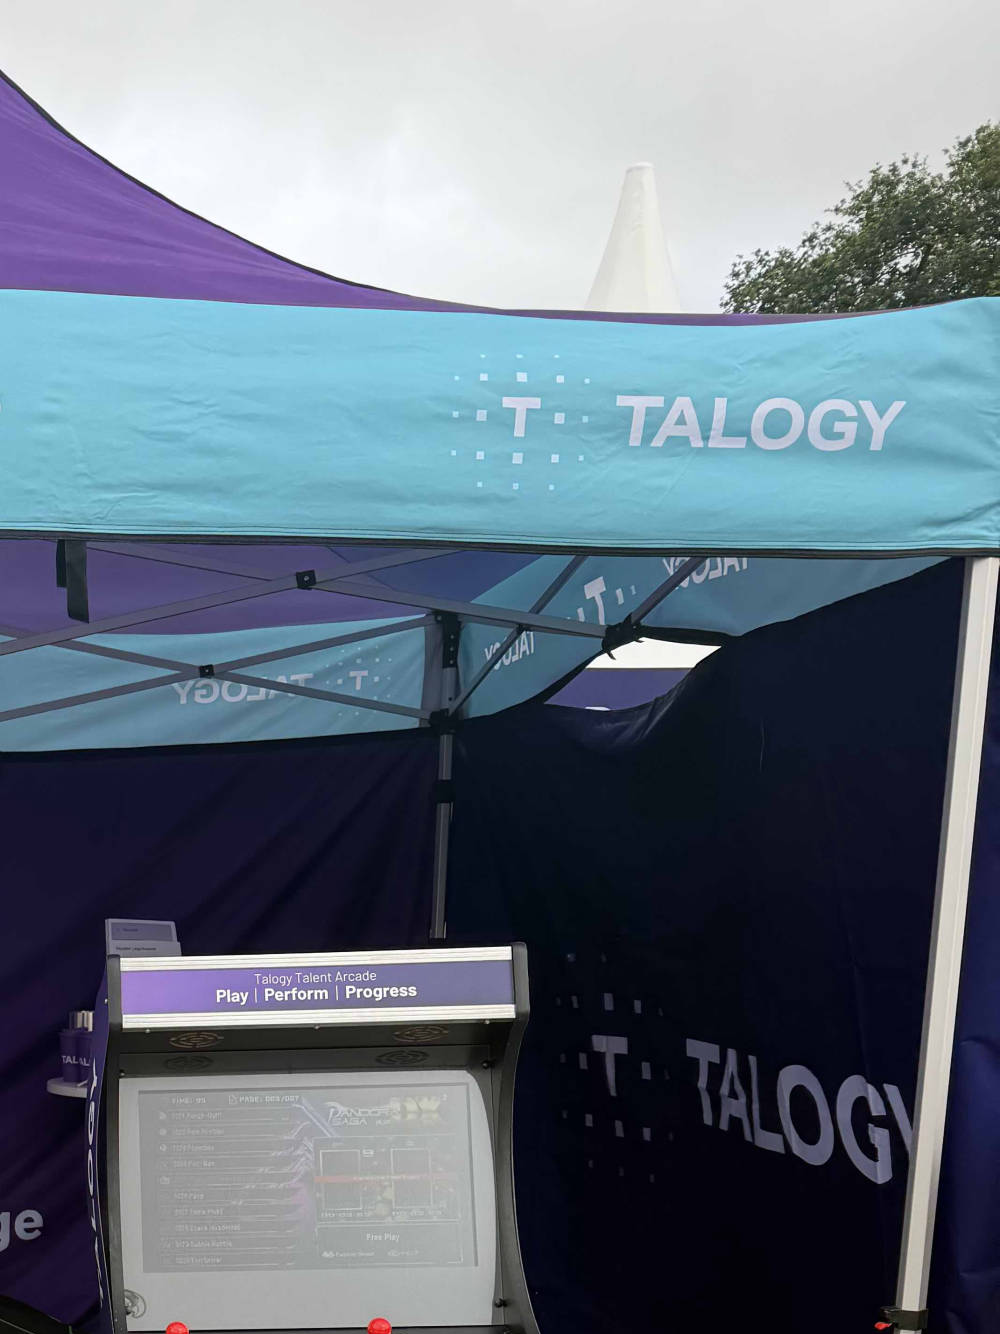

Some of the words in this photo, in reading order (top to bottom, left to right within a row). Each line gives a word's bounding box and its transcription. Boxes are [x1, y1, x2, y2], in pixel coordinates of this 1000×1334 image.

[502, 397, 541, 437] T
[616, 395, 906, 451] TALOGY
[254, 973, 292, 987] Talogy
[296, 972, 331, 984] Talent
[335, 971, 377, 982] Arcade
[216, 988, 249, 1005] Play
[264, 987, 329, 1001] Perform
[345, 985, 417, 1001] Progress
